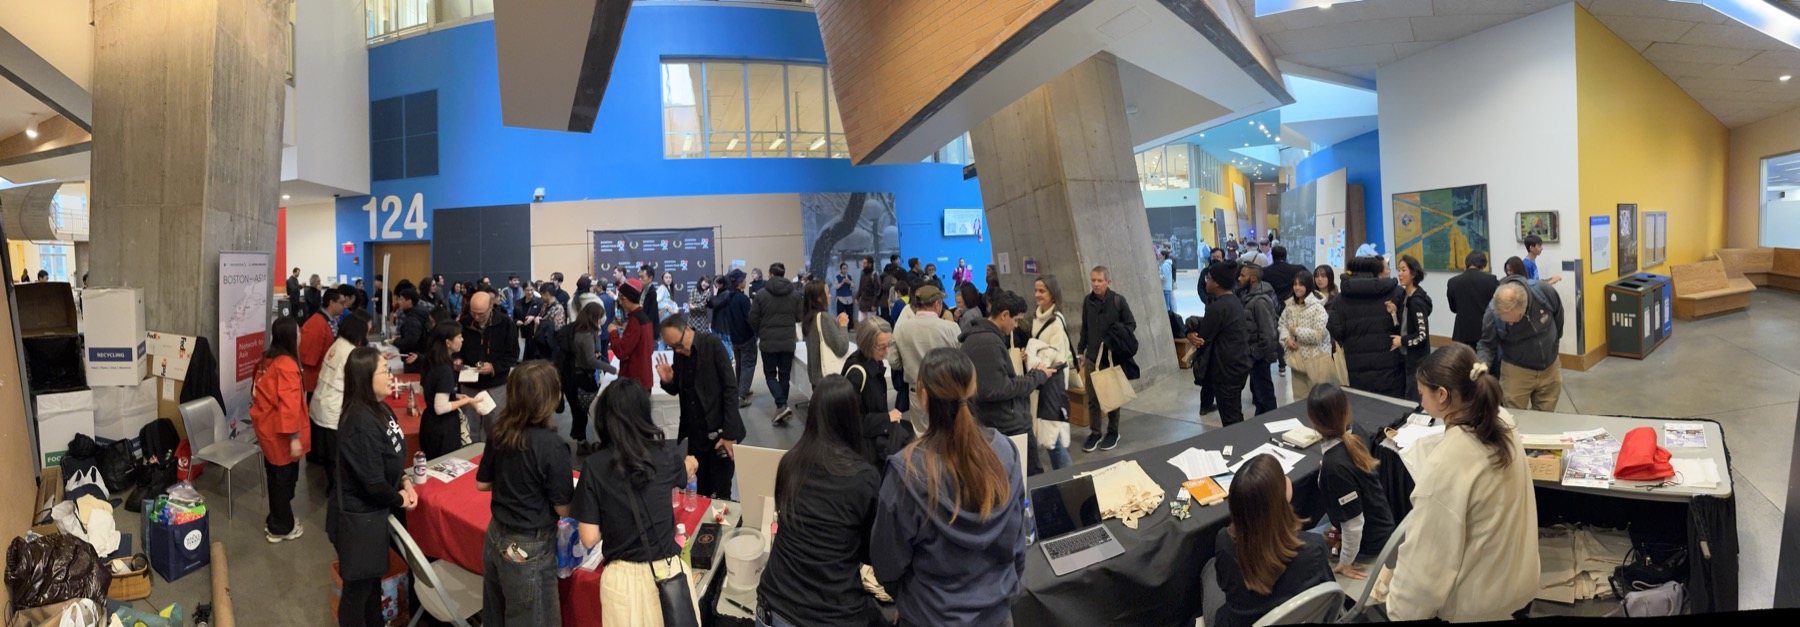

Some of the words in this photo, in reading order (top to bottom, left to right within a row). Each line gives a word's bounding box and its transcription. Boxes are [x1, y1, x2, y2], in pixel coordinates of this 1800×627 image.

[362, 192, 428, 241] 124
[223, 274, 249, 285] BOSTON
[96, 351, 125, 359] RECYCLING
